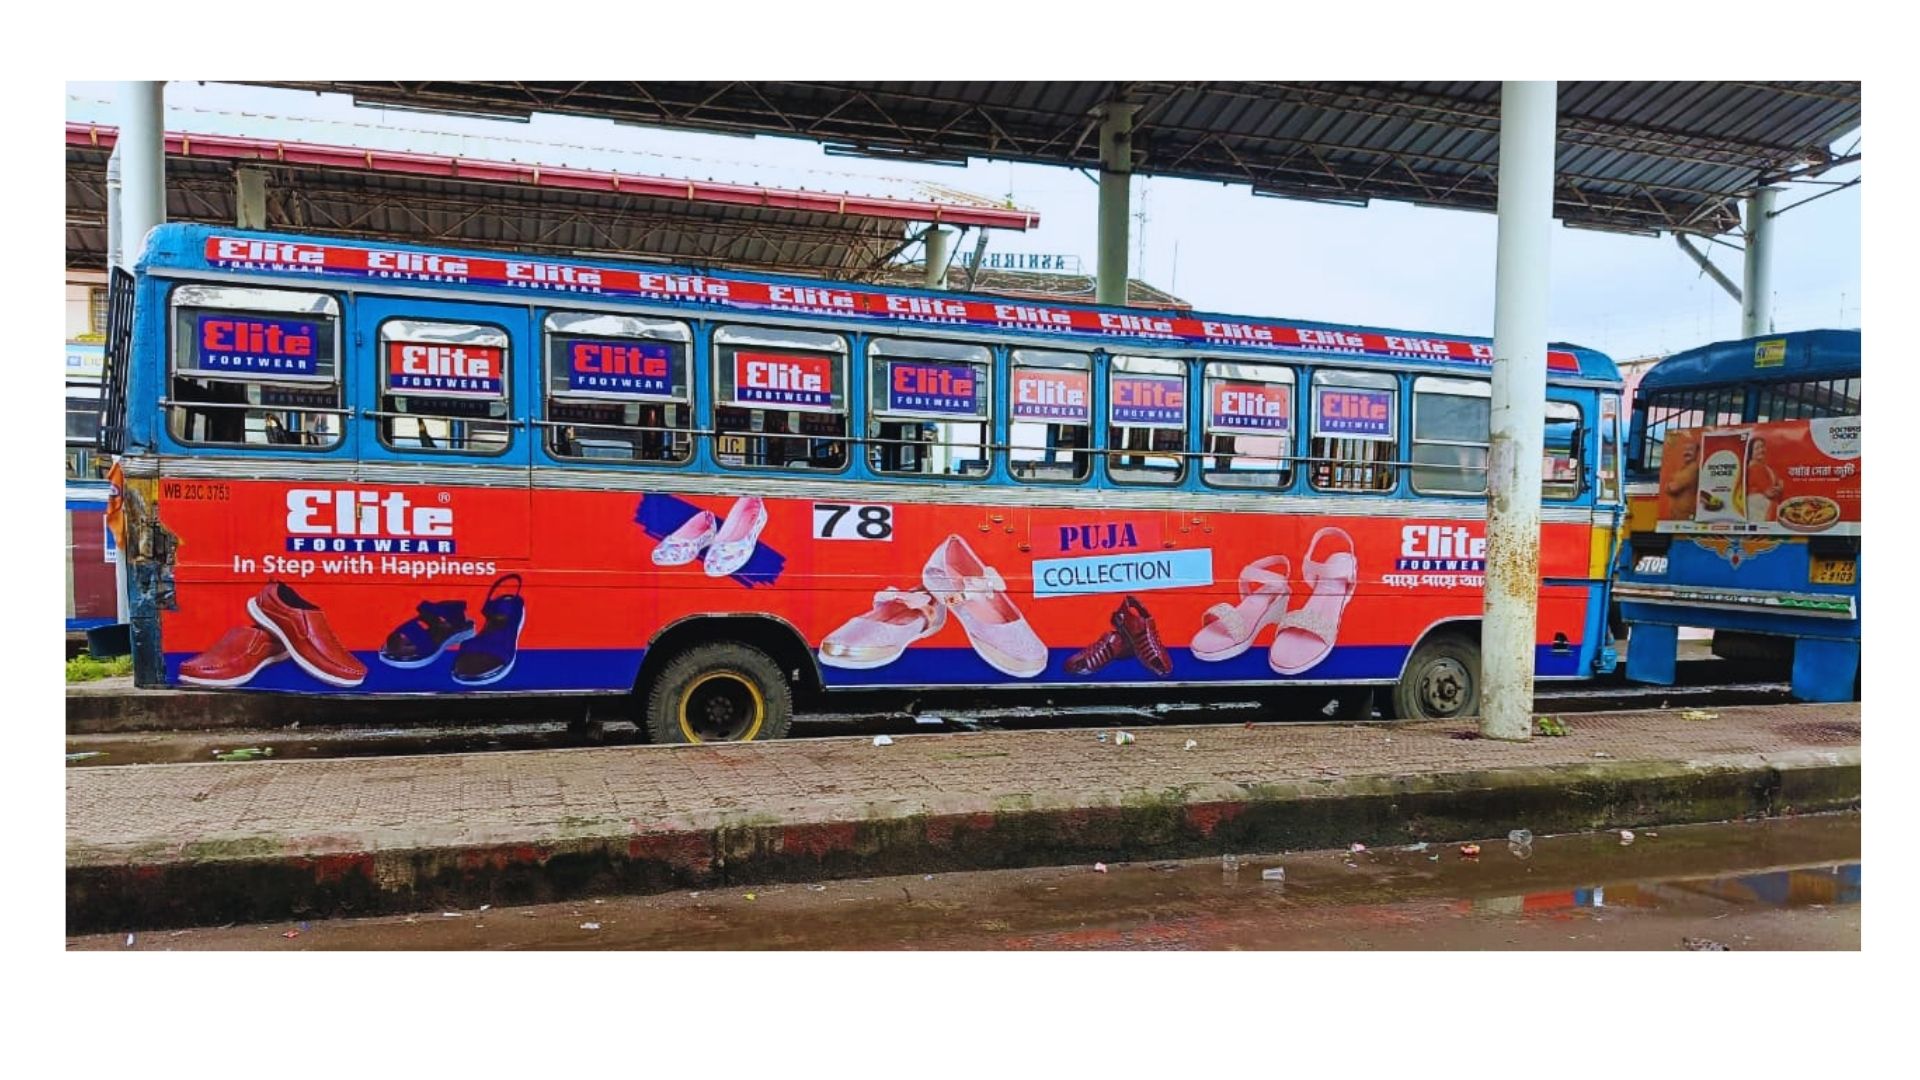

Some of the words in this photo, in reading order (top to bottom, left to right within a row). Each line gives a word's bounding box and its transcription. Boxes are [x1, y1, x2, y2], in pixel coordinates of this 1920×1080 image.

[217, 239, 324, 265] Elite
[218, 260, 323, 274] FOOTWEAR
[367, 251, 469, 275] Elite
[505, 262, 601, 285] Elite
[368, 270, 468, 283] FOOTWEAR
[507, 280, 601, 293] FOOTWEAR
[639, 273, 730, 297] Elite
[768, 285, 854, 308] Elite
[886, 296, 968, 317] Elite
[994, 304, 1071, 325] Elite
[1098, 313, 1173, 333] Elite
[203, 320, 310, 356] Elite
[1202, 321, 1273, 341] Elite
[1296, 328, 1364, 348] Elite
[1384, 335, 1450, 355] Elite
[208, 355, 306, 369] FOOTWEAR
[402, 345, 489, 377] Elite
[574, 344, 667, 377] Elite
[402, 376, 490, 390] FOOTWEAR
[578, 376, 664, 389] FOOTWEAR
[747, 360, 821, 392] Elite
[894, 366, 973, 397] Elite
[746, 390, 821, 403] FOOTWEAR
[897, 396, 970, 408] FOOTWEAR
[1019, 378, 1083, 406] Elite
[1114, 381, 1182, 407] Elite
[1018, 404, 1084, 416] FOOTWEAR
[1115, 408, 1181, 419] FOOTWEAR
[1221, 391, 1281, 417] Elite
[1322, 393, 1387, 419] Elite
[1221, 416, 1281, 427] FOOTWEAR
[1325, 419, 1385, 430] FOOTWEAR
[164, 483, 181, 498] WB
[185, 485, 204, 500] 23C
[286, 489, 453, 536] Elite
[814, 504, 893, 539] 78
[294, 538, 451, 553] FOOTWEAR
[1059, 523, 1138, 551] PUJA
[233, 555, 256, 574] In
[263, 555, 315, 578] Step
[322, 556, 374, 575] with
[381, 557, 496, 580] Happiness
[1043, 560, 1171, 587] COLLECTION
[1400, 560, 1481, 571] FOOTWEA
[1635, 556, 1668, 574] STOP
